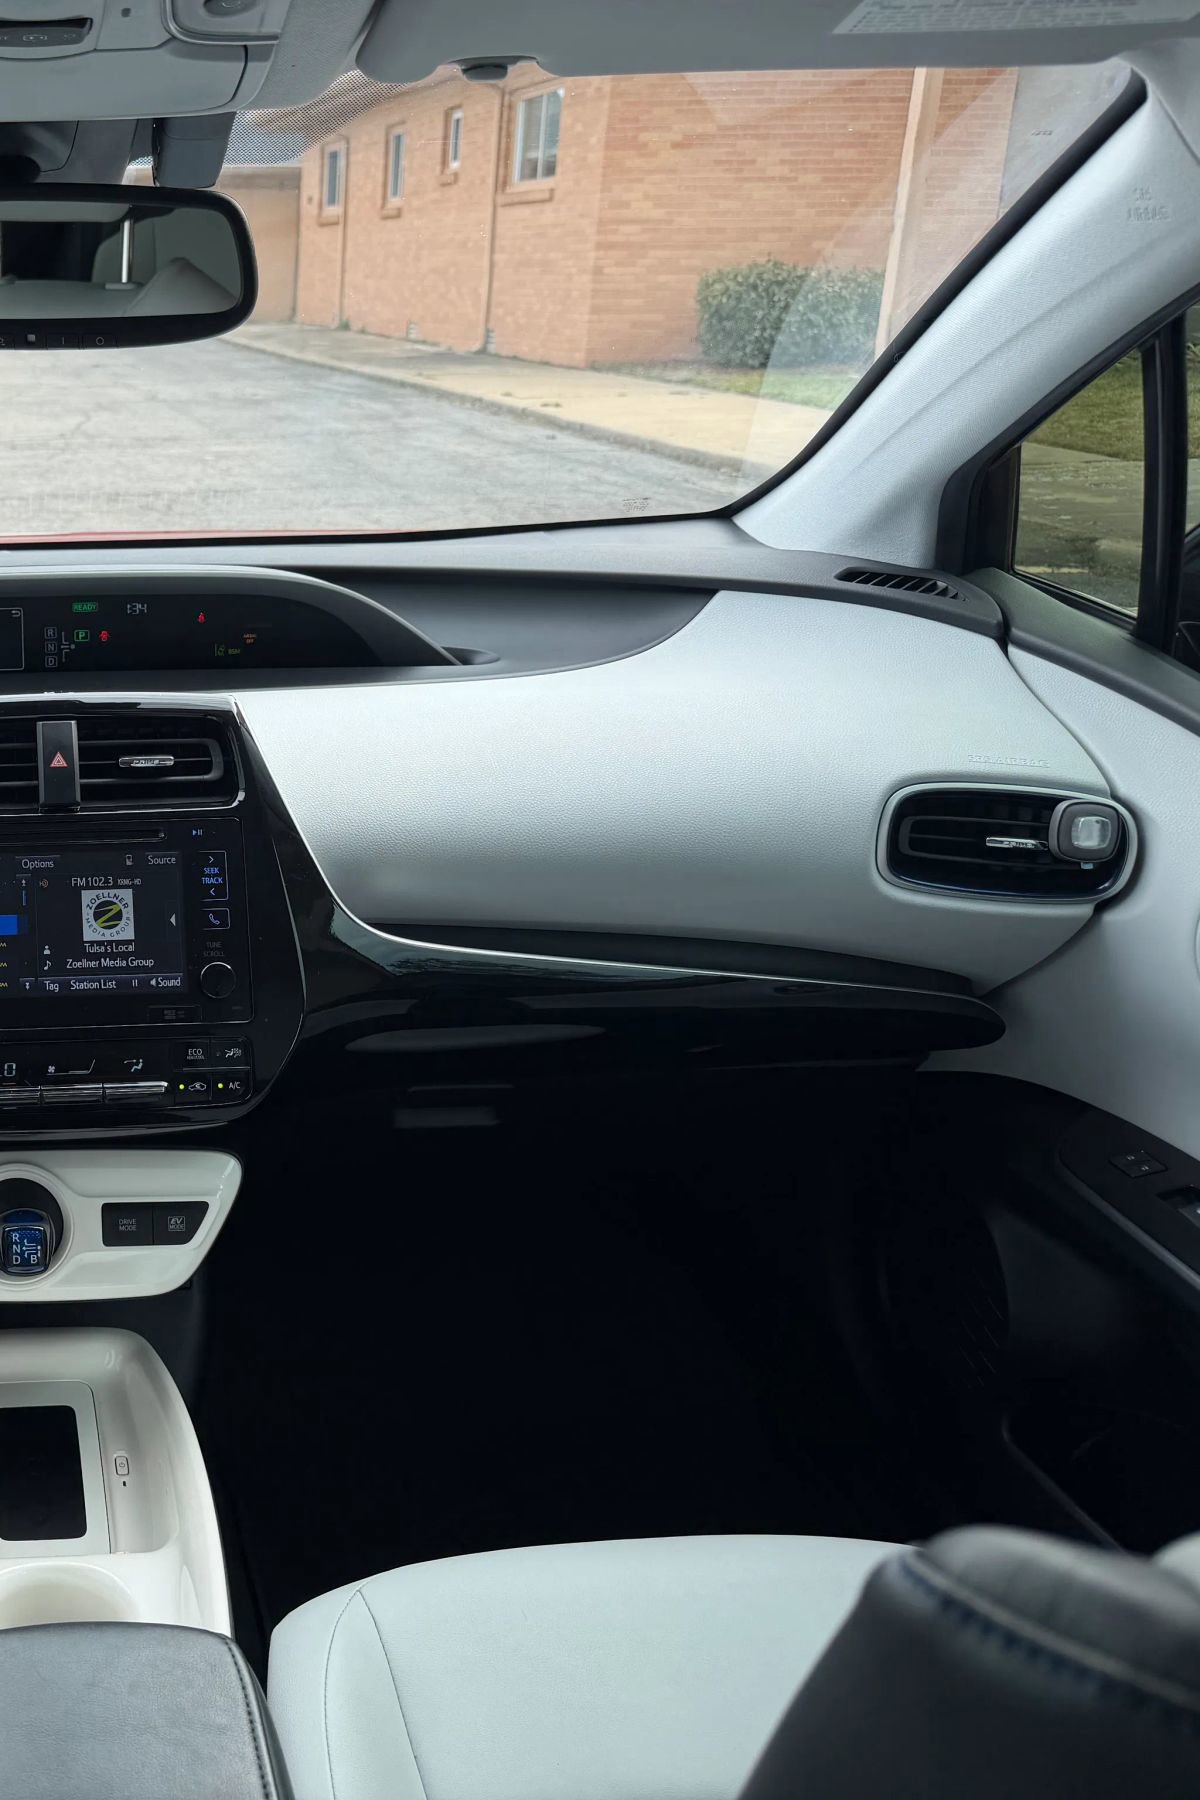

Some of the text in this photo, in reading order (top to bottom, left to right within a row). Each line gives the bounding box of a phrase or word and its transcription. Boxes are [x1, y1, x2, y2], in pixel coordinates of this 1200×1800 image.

[73, 603, 97, 611] READY
[21, 858, 55, 870] Options
[147, 855, 177, 865] Source
[71, 877, 86, 887] FM
[87, 876, 113, 887] 102.3
[201, 877, 224, 885] TRACK
[86, 891, 129, 911] ZOELLNER
[85, 916, 131, 938] MEDIA GROUP
[84, 941, 135, 953] Tulsa's Local
[66, 957, 154, 969] Zoellner Media Group
[43, 979, 117, 992] Tag Station List
[157, 976, 181, 987] Sound
[228, 1081, 241, 1089] A/C
[12, 1233, 20, 1243] R
[12, 1244, 21, 1254] N
[12, 1255, 21, 1265] D
[30, 1254, 38, 1264] B
